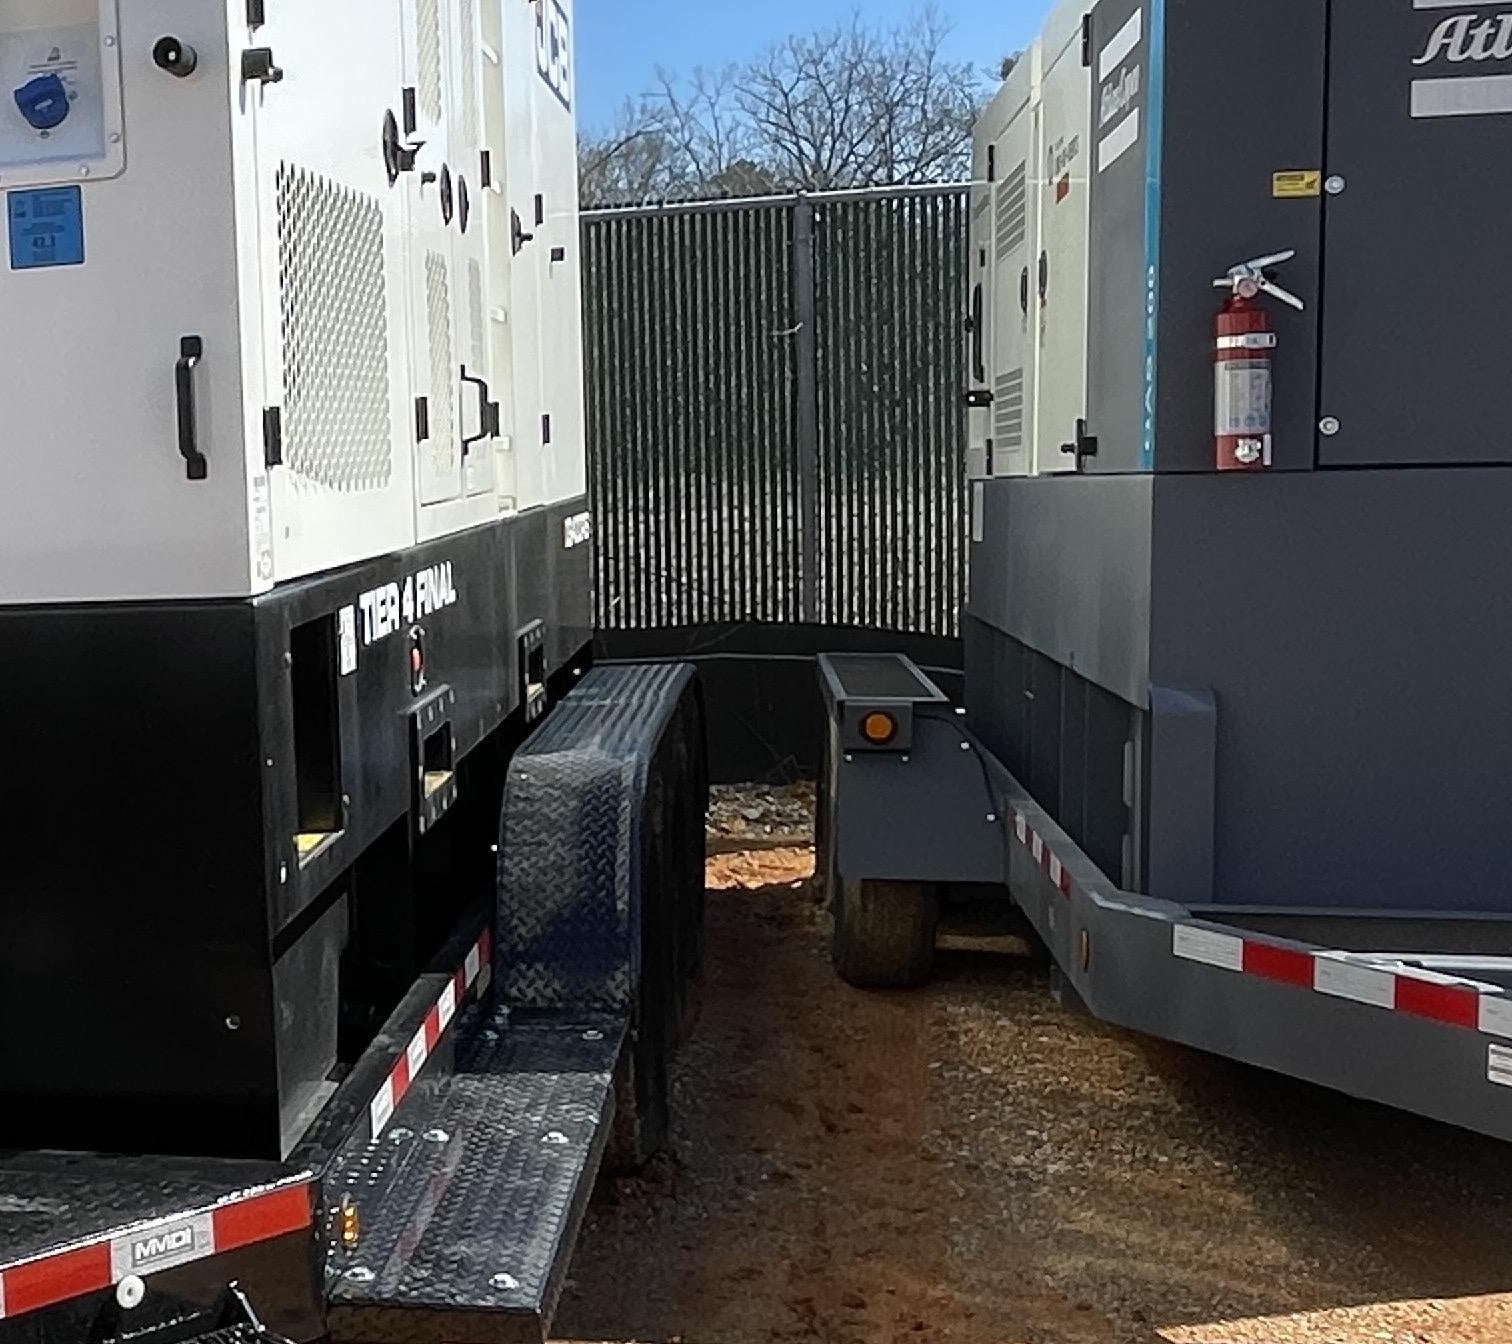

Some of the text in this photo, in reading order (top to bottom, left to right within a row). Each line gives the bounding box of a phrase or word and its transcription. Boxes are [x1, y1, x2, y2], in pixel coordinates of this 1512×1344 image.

[359, 582, 400, 645] TIER
[402, 576, 414, 623] 4
[416, 560, 456, 618] FINAL
